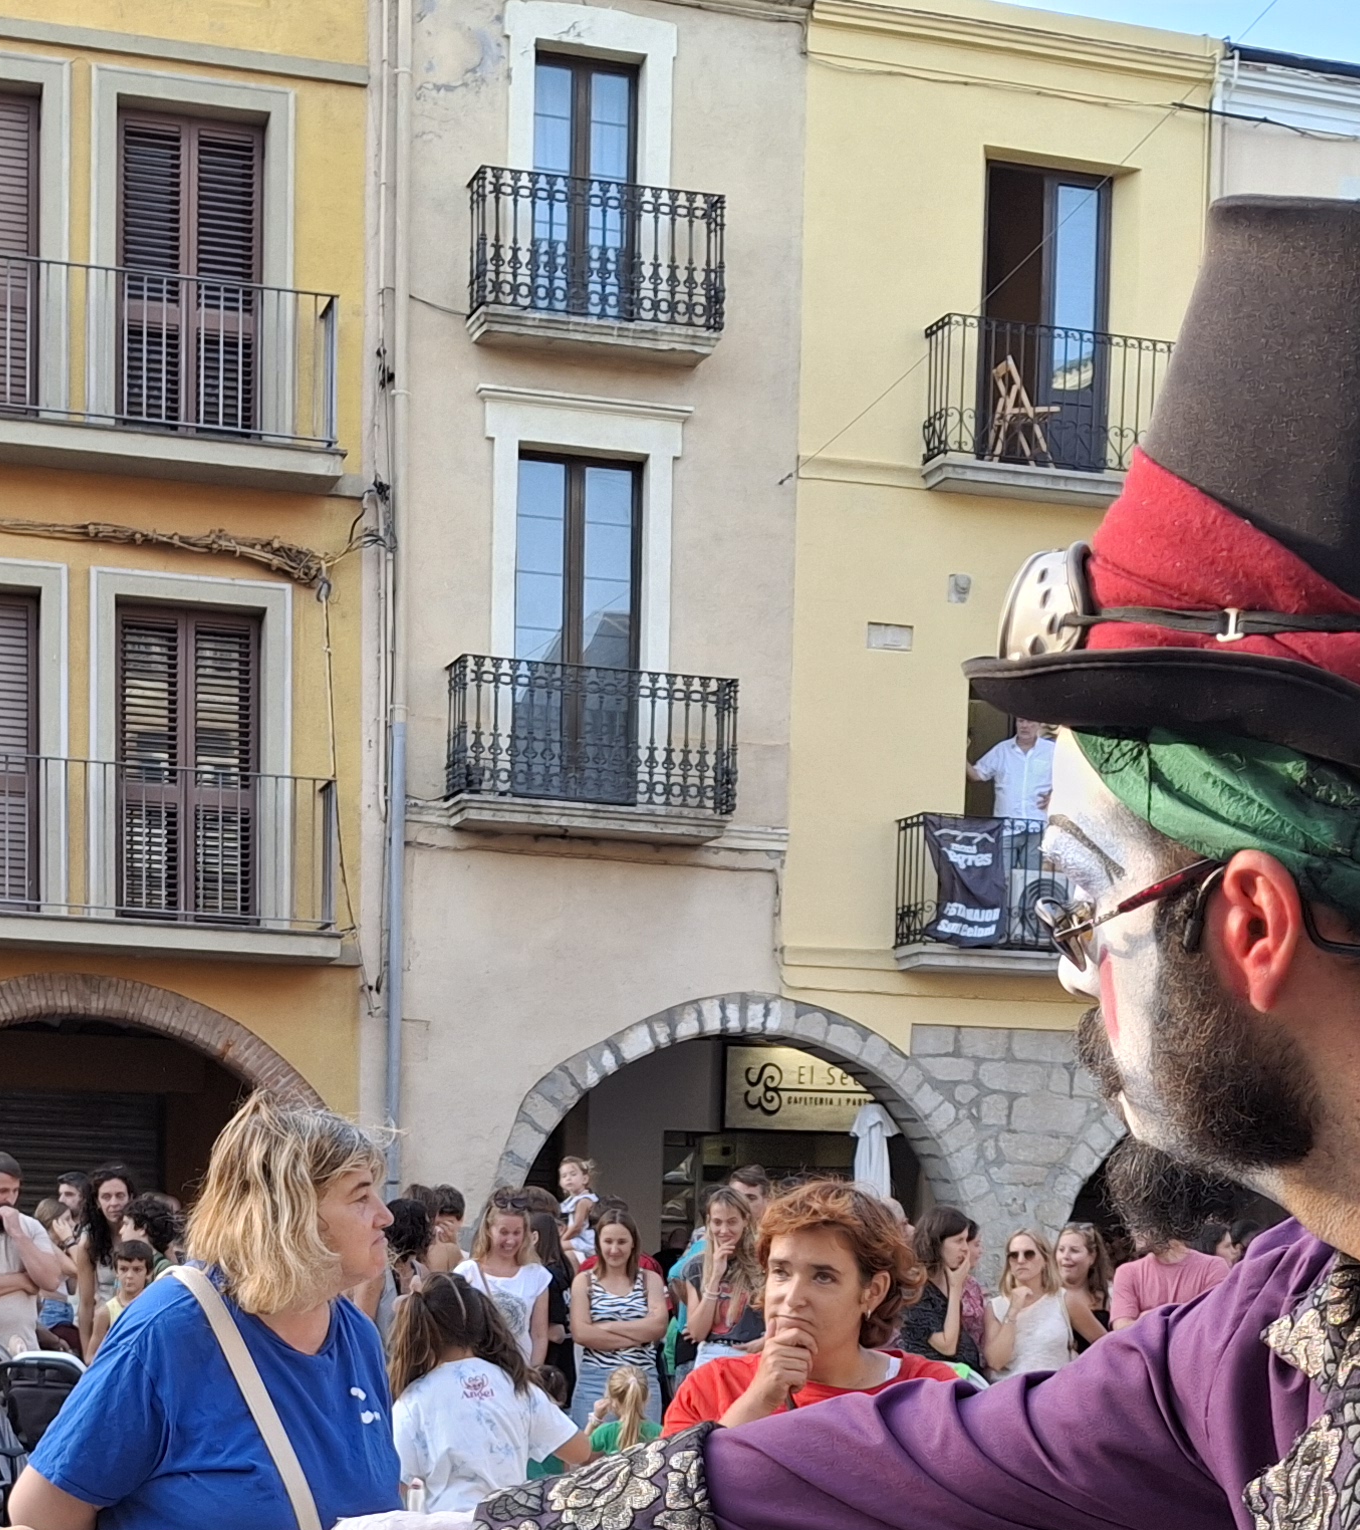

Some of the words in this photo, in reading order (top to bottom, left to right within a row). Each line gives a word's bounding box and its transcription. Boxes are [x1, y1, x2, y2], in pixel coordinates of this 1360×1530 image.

[797, 1065, 815, 1086] El
[786, 1095, 834, 1107] CAFETERIA
[461, 1388, 495, 1401] Angel
